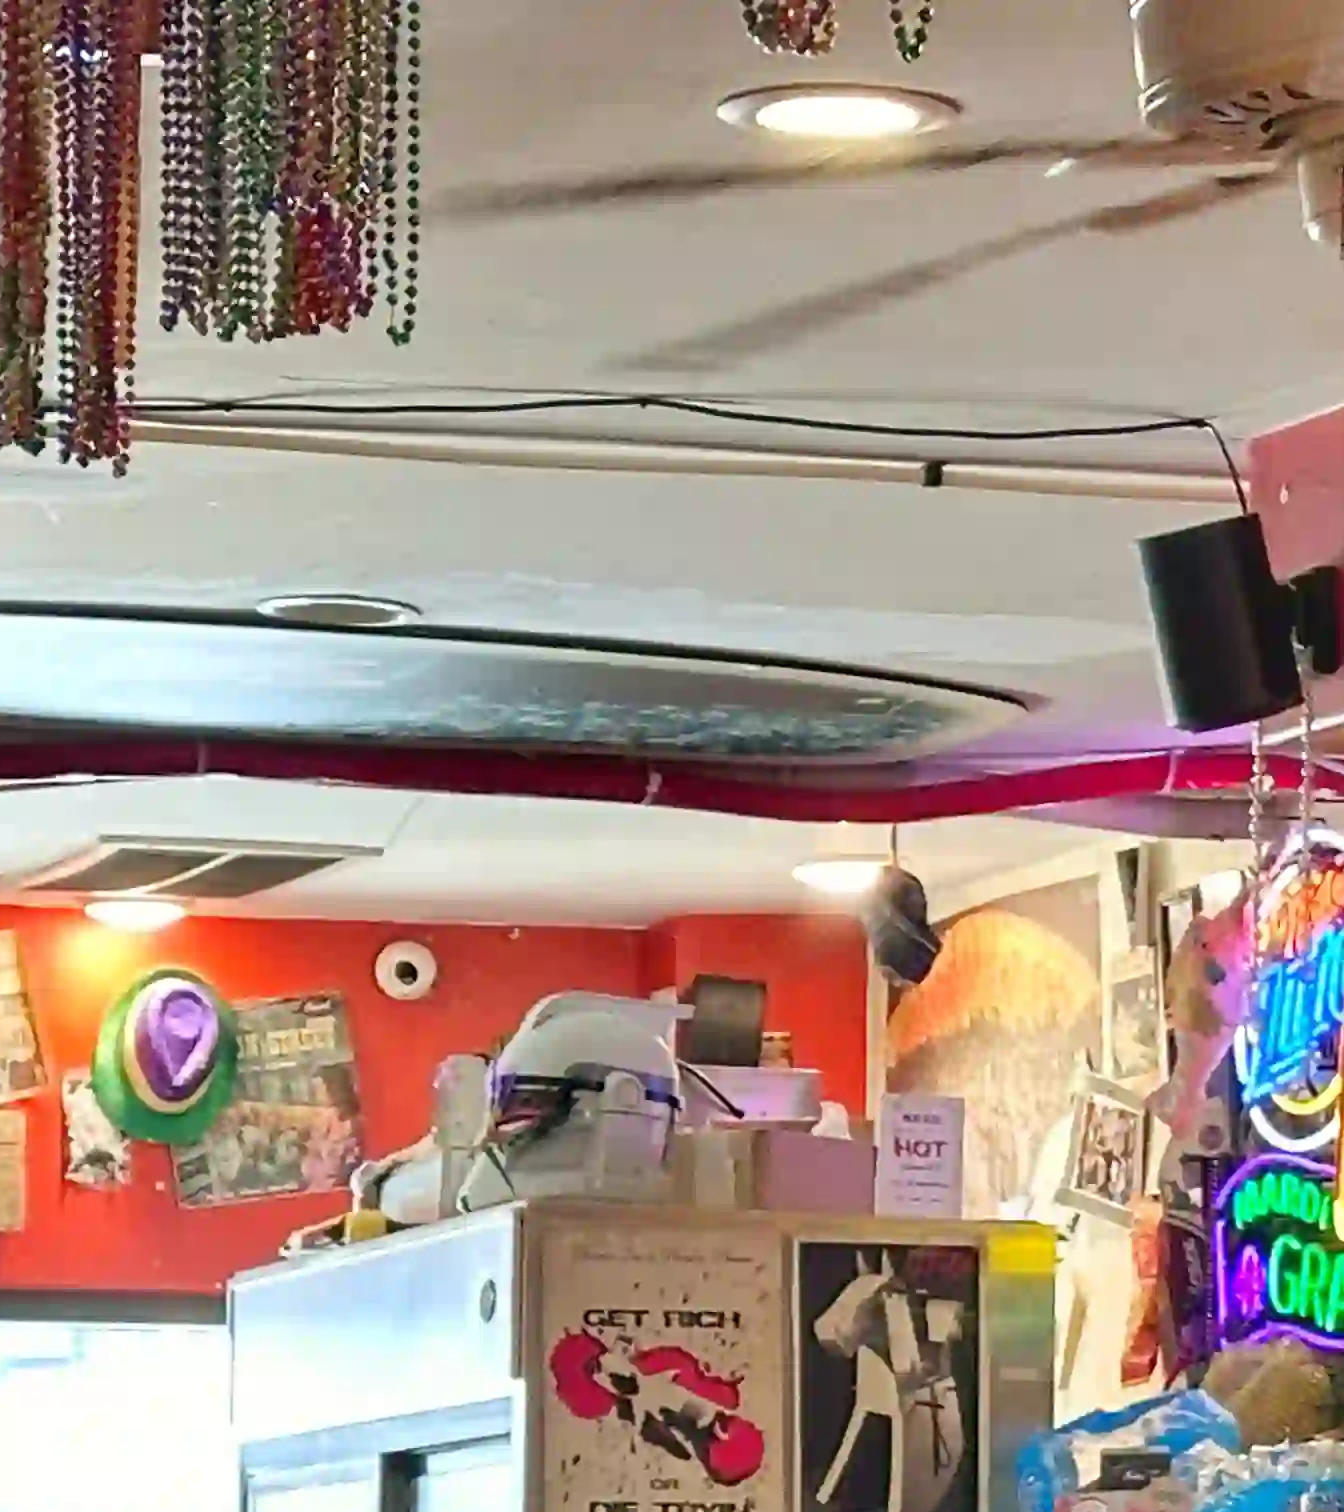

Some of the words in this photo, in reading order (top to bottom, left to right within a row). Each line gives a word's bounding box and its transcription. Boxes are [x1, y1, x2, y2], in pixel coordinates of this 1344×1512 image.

[894, 1137, 949, 1158] HOT
[1233, 1172, 1332, 1230] MARDI
[583, 1309, 649, 1327] GET
[663, 1310, 741, 1328] RICH
[650, 1479, 679, 1490] OR
